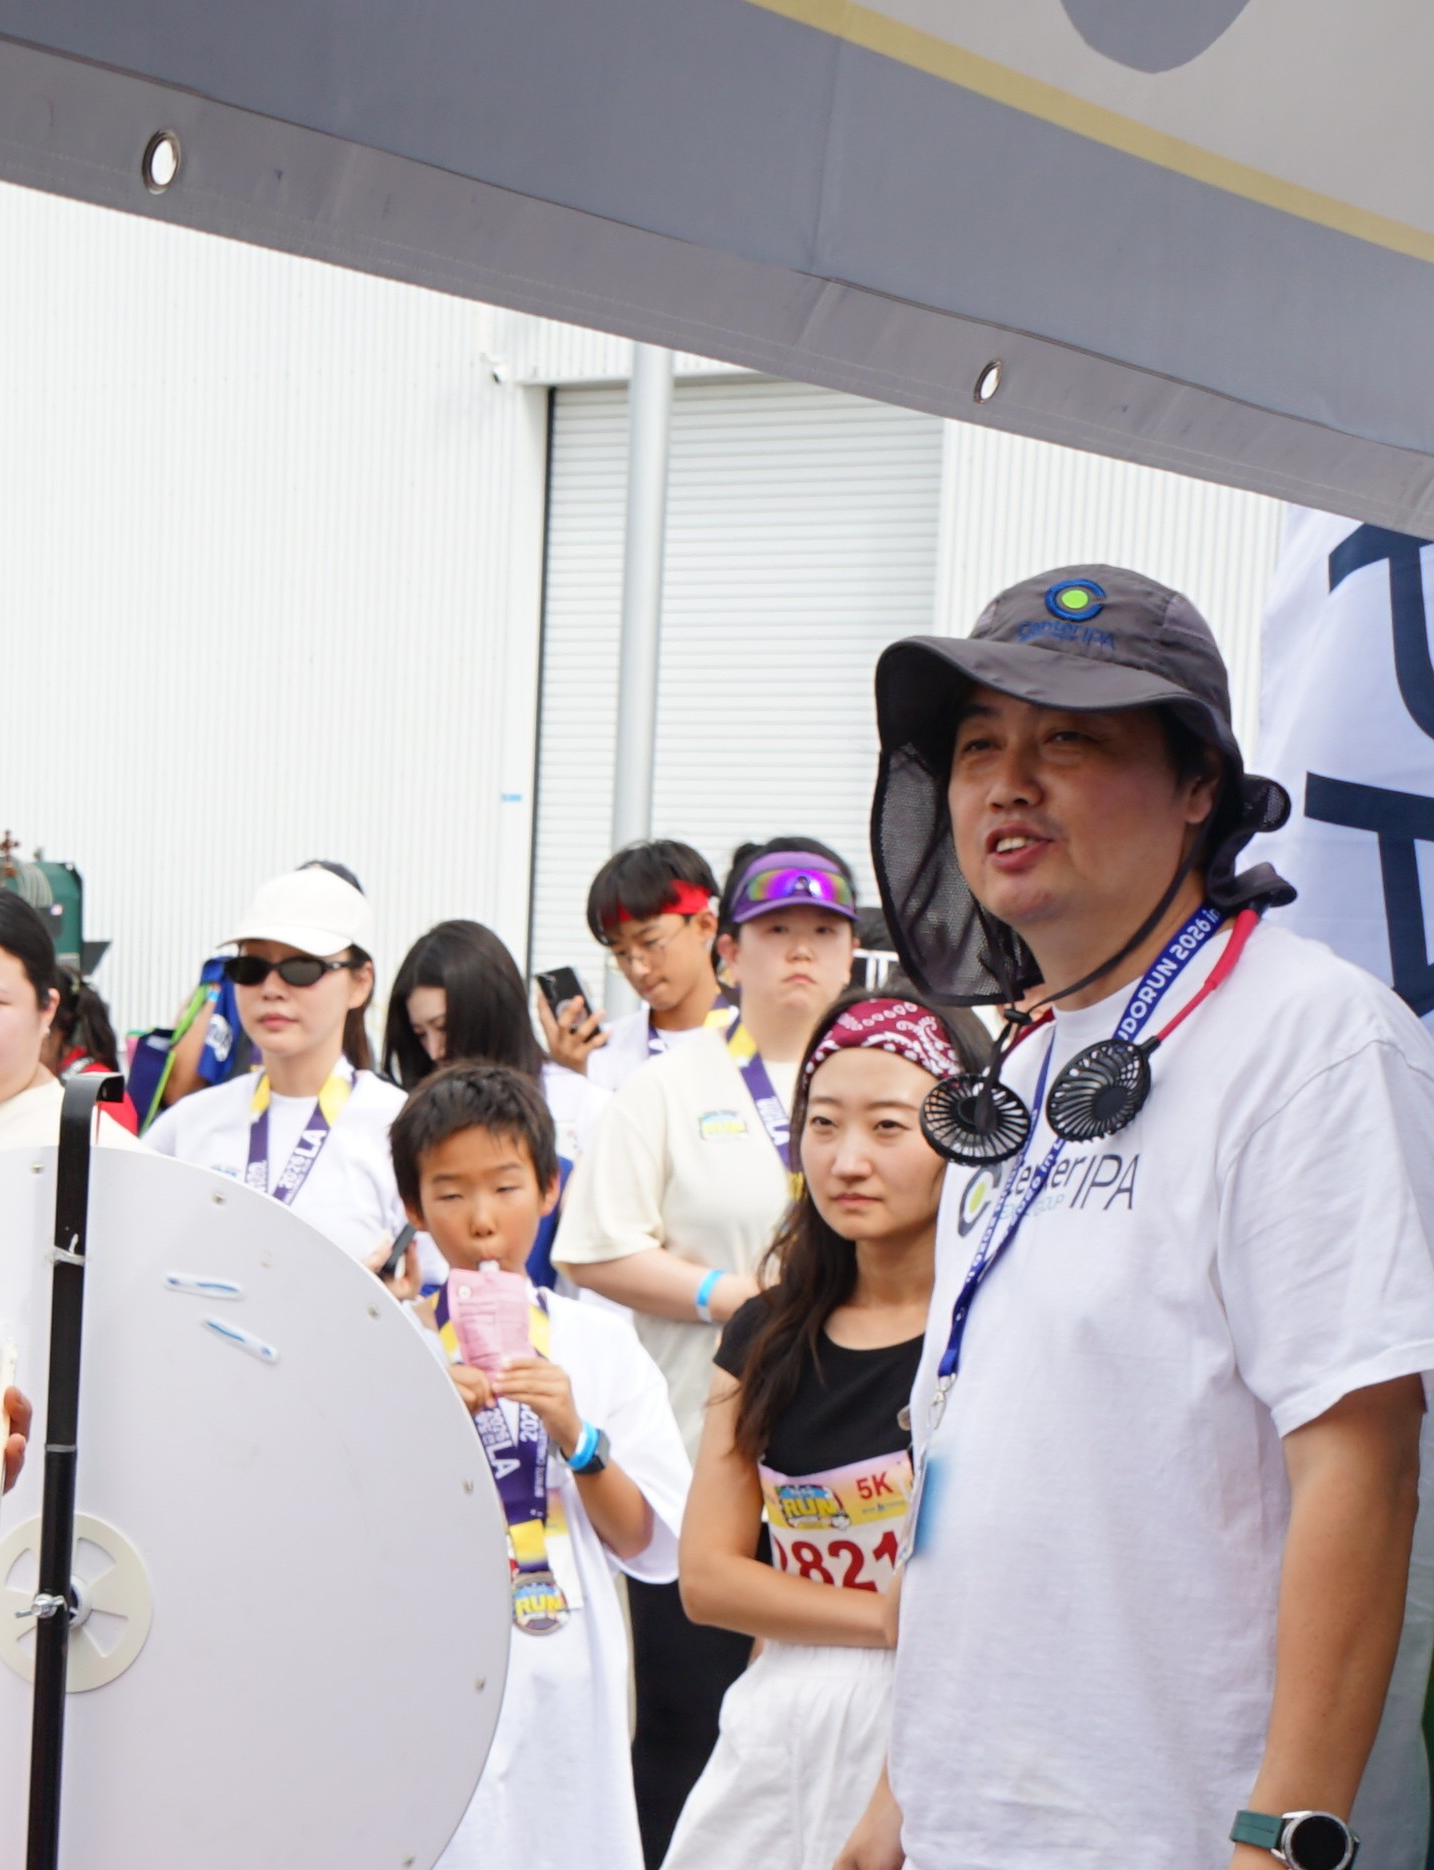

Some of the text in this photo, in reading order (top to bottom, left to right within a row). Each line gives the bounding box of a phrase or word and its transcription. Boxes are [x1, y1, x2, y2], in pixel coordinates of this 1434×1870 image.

[1118, 958, 1178, 1040] DORUN
[1170, 918, 1211, 960] 2026
[1069, 1154, 1140, 1210] IPA
[486, 1440, 521, 1480] LA
[856, 1471, 894, 1500] 5K
[780, 1497, 839, 1519] RUN
[515, 1596, 564, 1618] RUN
